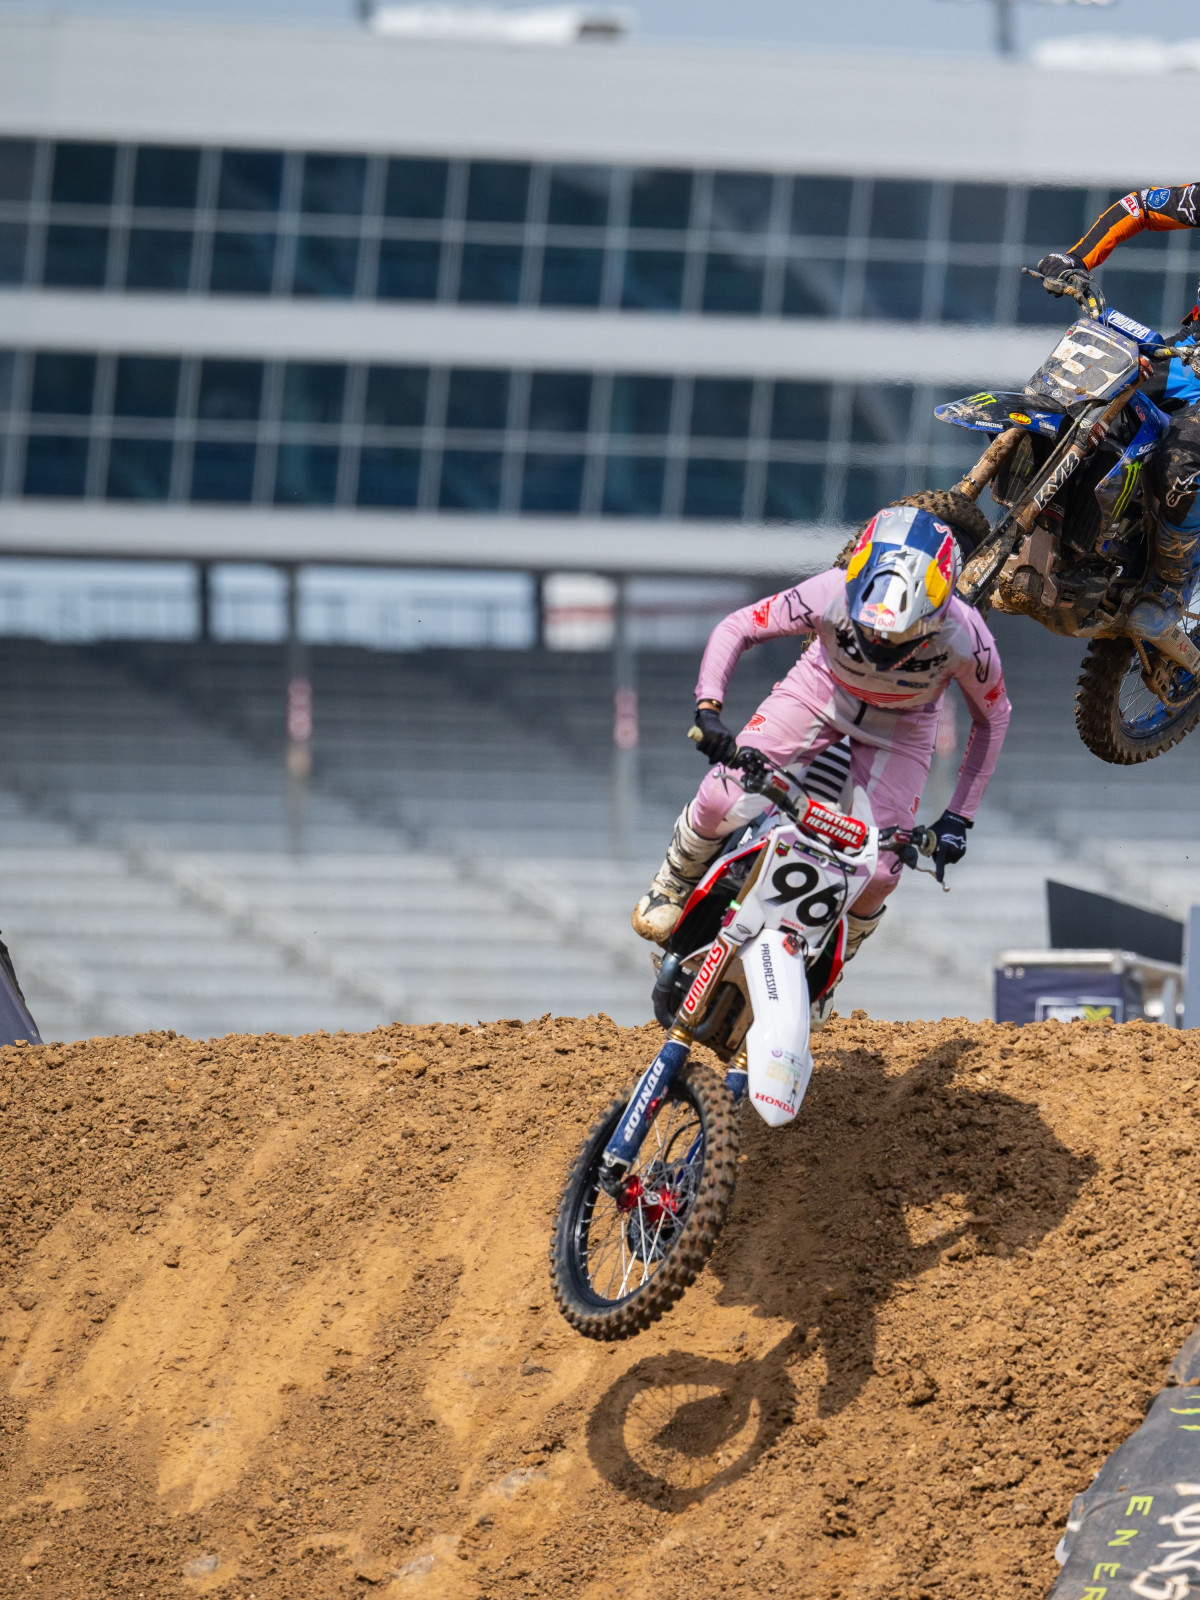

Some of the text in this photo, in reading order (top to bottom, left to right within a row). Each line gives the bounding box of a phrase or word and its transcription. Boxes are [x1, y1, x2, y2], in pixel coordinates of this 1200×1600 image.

[1043, 330, 1133, 393] 3
[1034, 451, 1080, 511] KYB
[805, 816, 859, 845] RENTHAL
[810, 805, 863, 836] RENTHAL
[763, 862, 846, 928] 96
[684, 945, 723, 1013] SHOWA
[760, 942, 779, 1002] PROGRESSIVE
[623, 1056, 666, 1143] DUNLOP
[754, 1091, 796, 1117] HONDA
